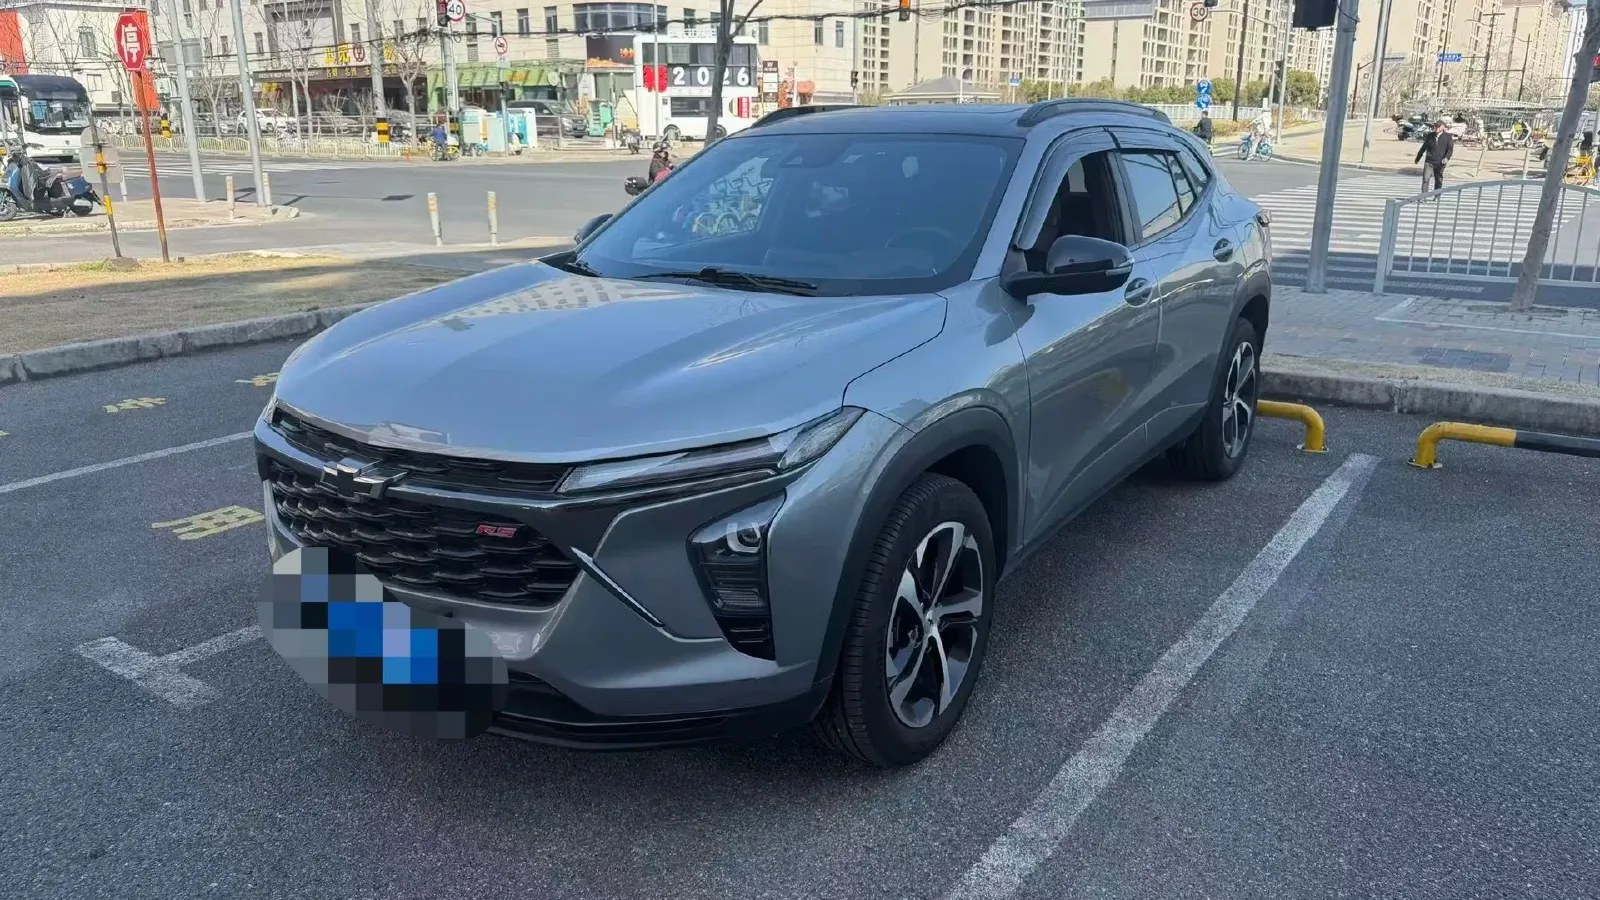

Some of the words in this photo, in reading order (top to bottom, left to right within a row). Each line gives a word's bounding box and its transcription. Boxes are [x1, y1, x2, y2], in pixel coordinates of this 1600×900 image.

[448, 4, 463, 15] 40
[1193, 7, 1205, 17] 30
[121, 23, 142, 63] 停
[475, 524, 517, 538] RS
